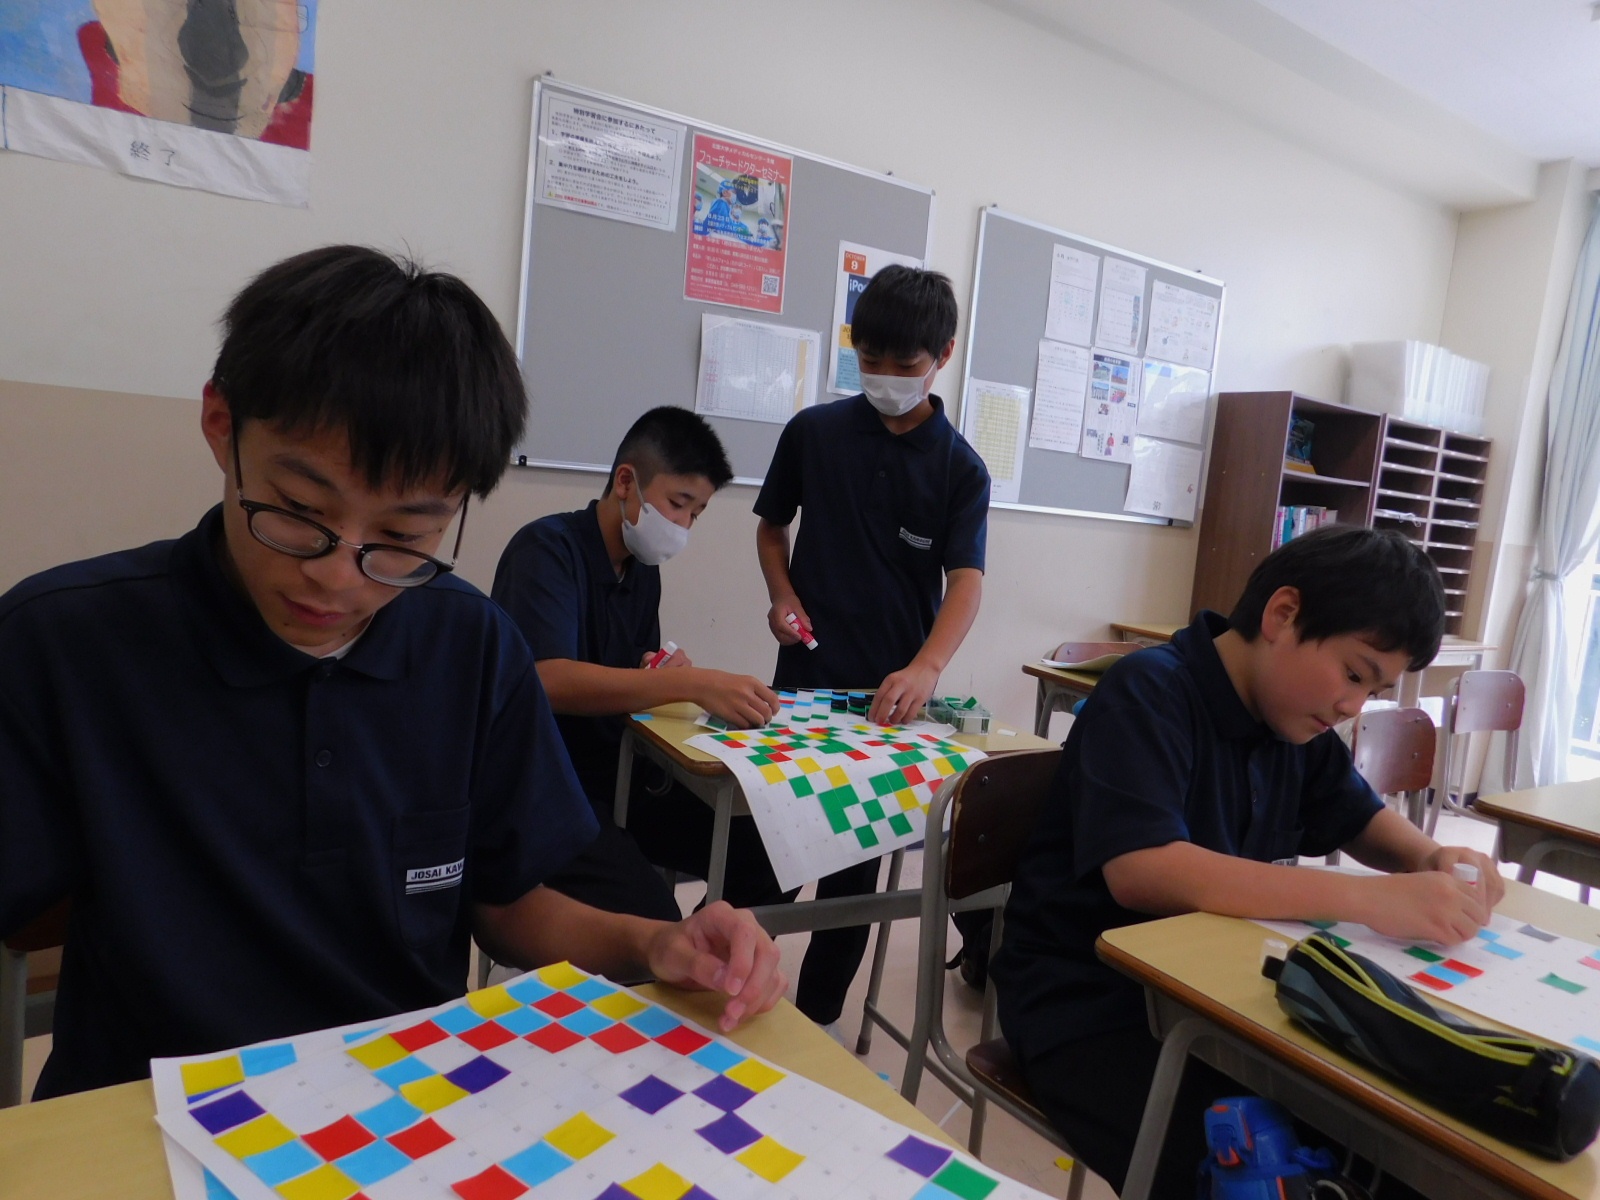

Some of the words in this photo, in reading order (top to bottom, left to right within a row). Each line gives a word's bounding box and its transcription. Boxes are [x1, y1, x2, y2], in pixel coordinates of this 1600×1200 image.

[130, 140, 175, 167] 終了
[699, 150, 785, 181] フューチャードクターセミナー
[845, 252, 866, 262] OCTOBER
[851, 261, 859, 270] 9
[411, 869, 442, 880] JOSAI
